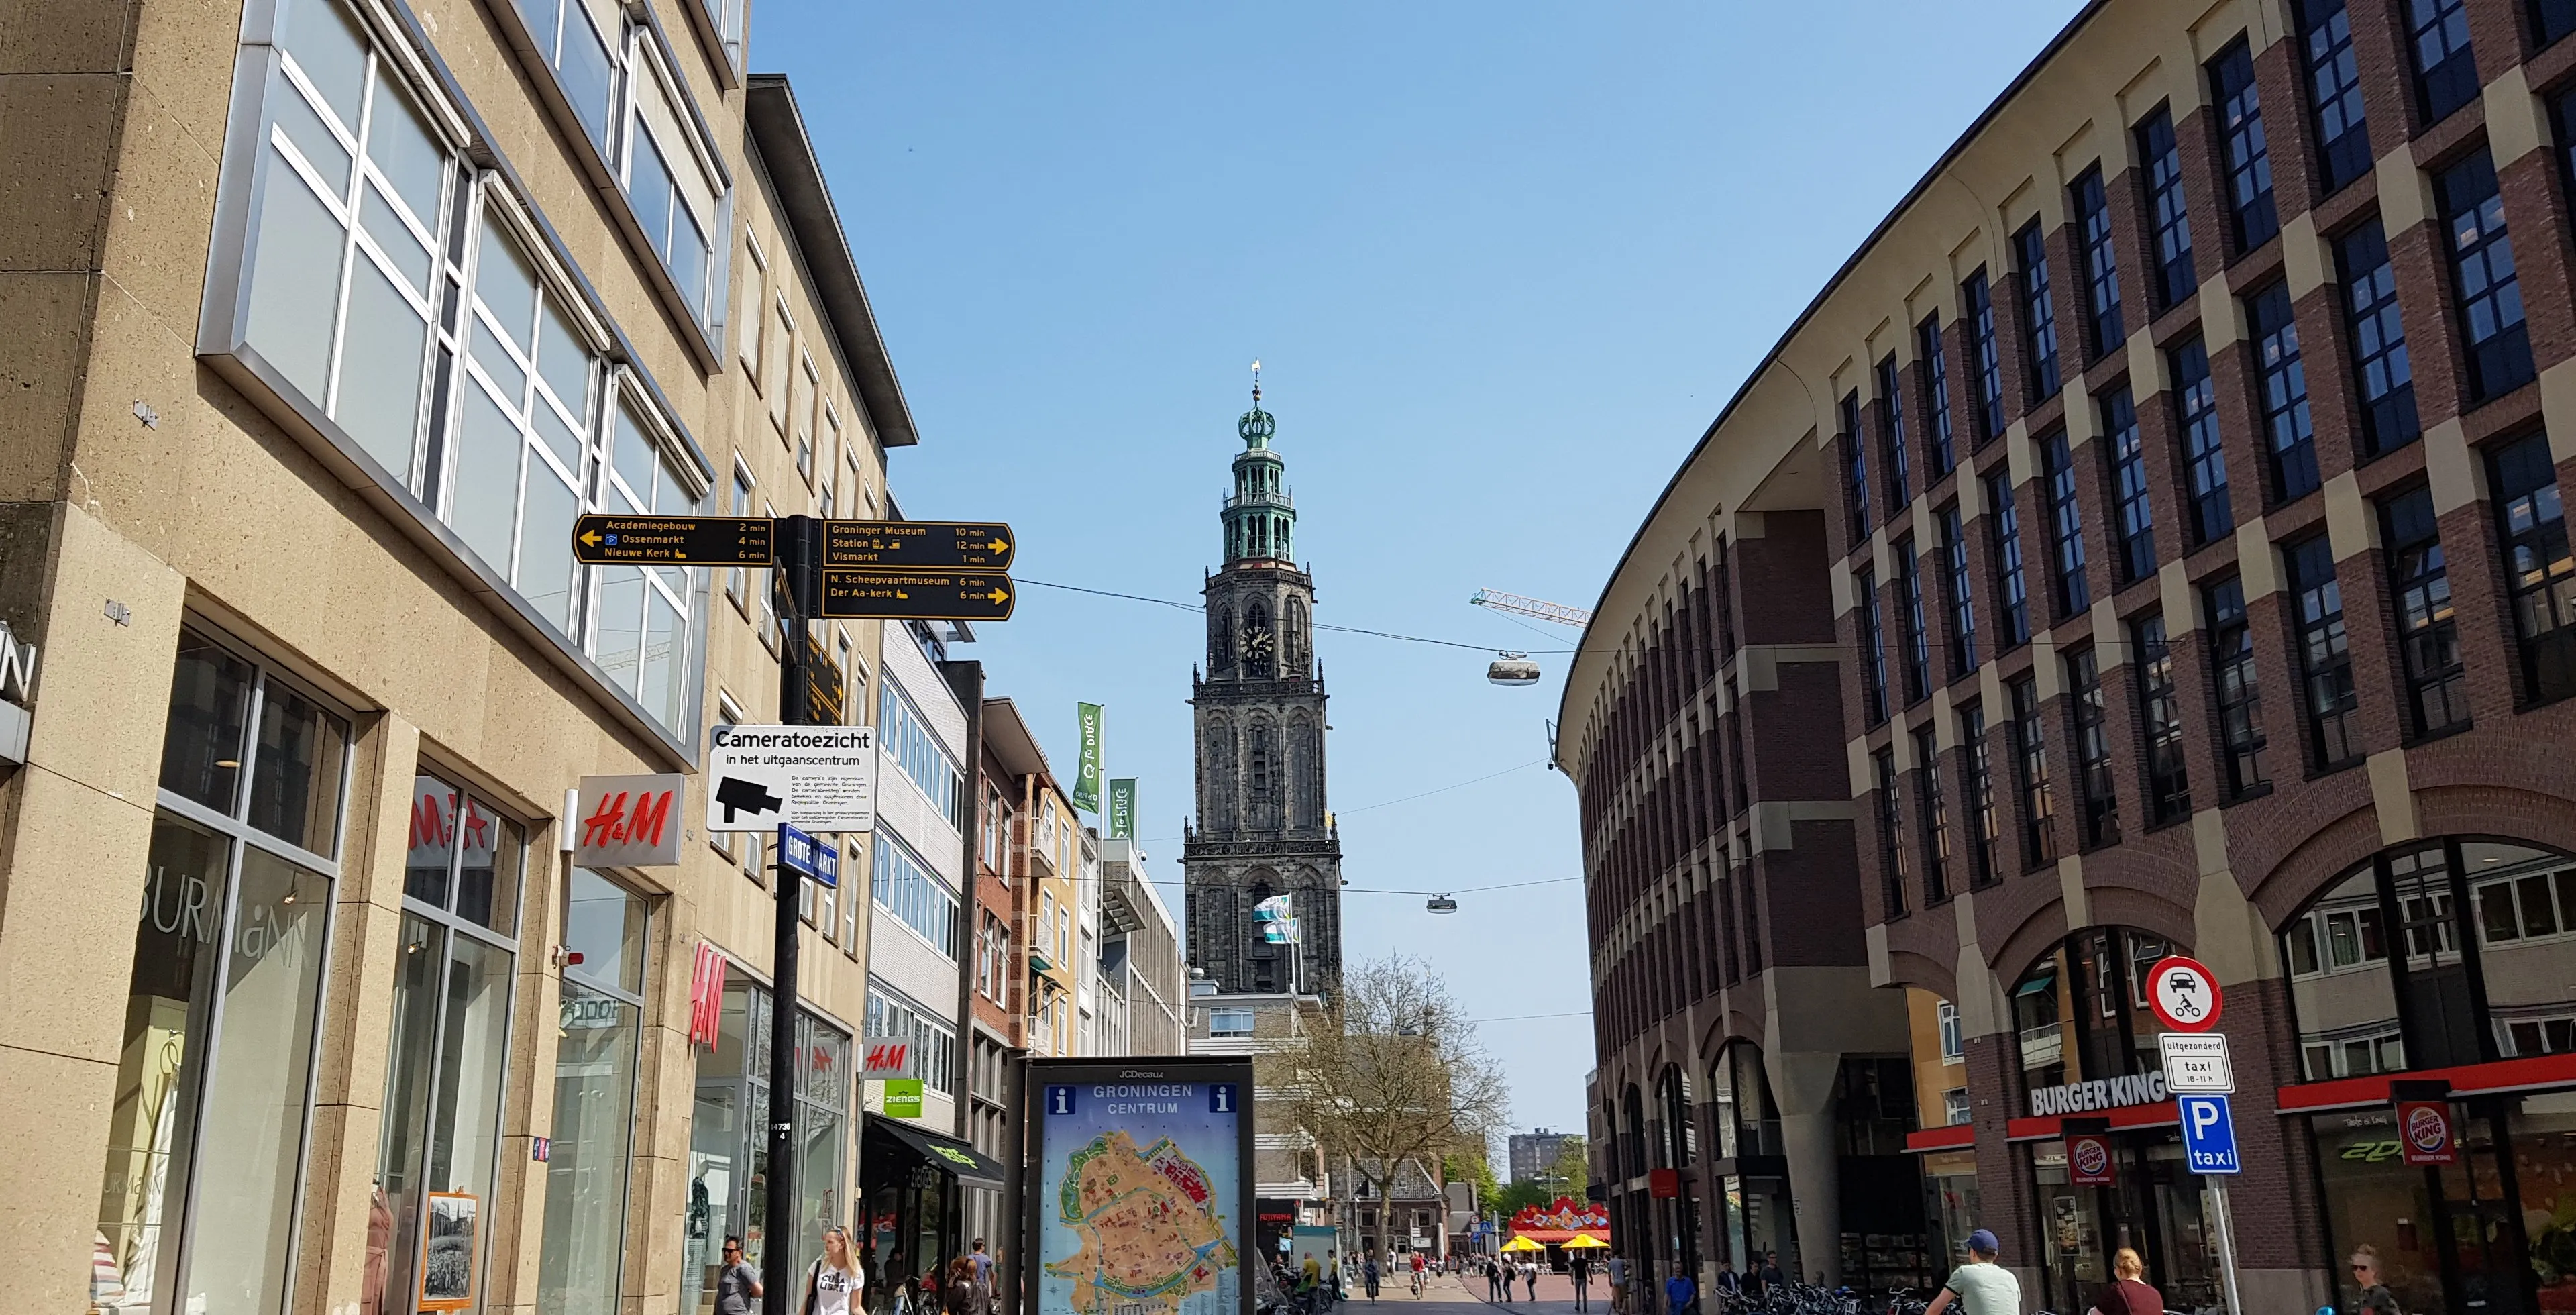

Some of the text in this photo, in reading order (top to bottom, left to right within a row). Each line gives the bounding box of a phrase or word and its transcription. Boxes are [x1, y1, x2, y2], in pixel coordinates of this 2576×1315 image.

[606, 521, 696, 532] Academiegebouw
[739, 523, 746, 531] 2
[832, 525, 881, 537] Groninger
[885, 526, 926, 535] Museum
[955, 528, 966, 537] 10
[622, 534, 684, 544] Ossenmarkt
[739, 537, 746, 545] 4
[749, 537, 765, 545] min
[832, 539, 985, 550] Station 12 min
[604, 548, 765, 559] Nieuwe Kerk 6 min
[832, 552, 879, 562] Vismarkt
[963, 555, 967, 563] 1
[831, 575, 842, 583] N.
[845, 575, 950, 586] Scheepvaartmuseum
[959, 578, 966, 586] 6
[830, 588, 985, 600] Der Aa-kerk 6 min
[716, 730, 870, 749] Cameratoezicht
[727, 755, 860, 768] in het uitgaanscentrum
[584, 790, 674, 848] H&M
[788, 835, 837, 877] GROTE MARKT
[2167, 1041, 2221, 1052] uitgezonderd
[865, 1044, 906, 1071] H&M
[2184, 1061, 2212, 1071] taxi
[1119, 1070, 1164, 1079] JCDecaux
[1093, 1084, 1193, 1098] GRONINGEN
[2030, 1070, 2167, 1117] BURGER KING
[885, 1096, 920, 1104] ZIENGS
[1108, 1102, 1179, 1114] CENTRUM
[2190, 1101, 2219, 1140] P
[2411, 1115, 2439, 1132] BURGER
[780, 1132, 786, 1140] 4
[2414, 1122, 2442, 1142] KING
[2077, 1145, 2101, 1159] BURGER
[2194, 1149, 2233, 1165] taxi
[2080, 1152, 2103, 1168] KING
